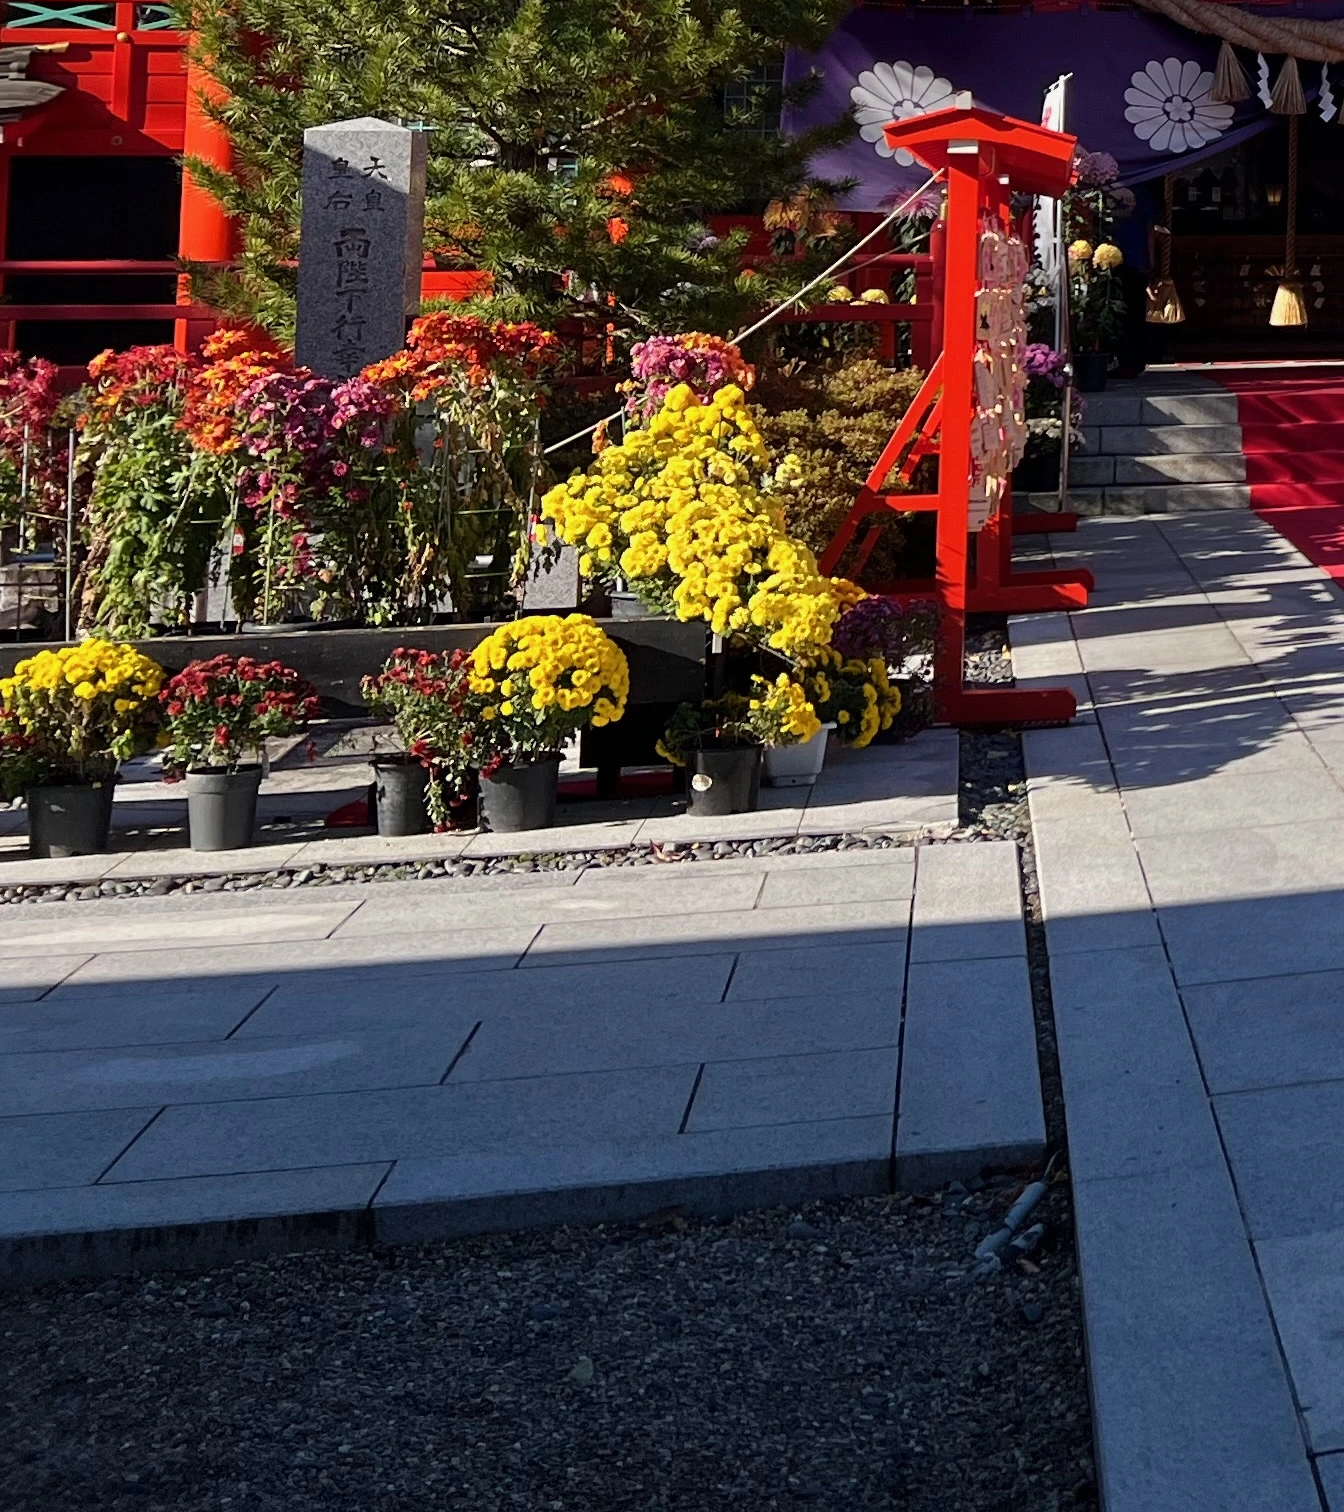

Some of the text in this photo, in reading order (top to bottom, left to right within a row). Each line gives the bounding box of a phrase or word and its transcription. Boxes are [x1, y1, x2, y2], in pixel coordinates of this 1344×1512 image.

[322, 156, 354, 211] 皇后
[362, 155, 388, 212] 天皇
[330, 227, 371, 382] 両陛下行幸
